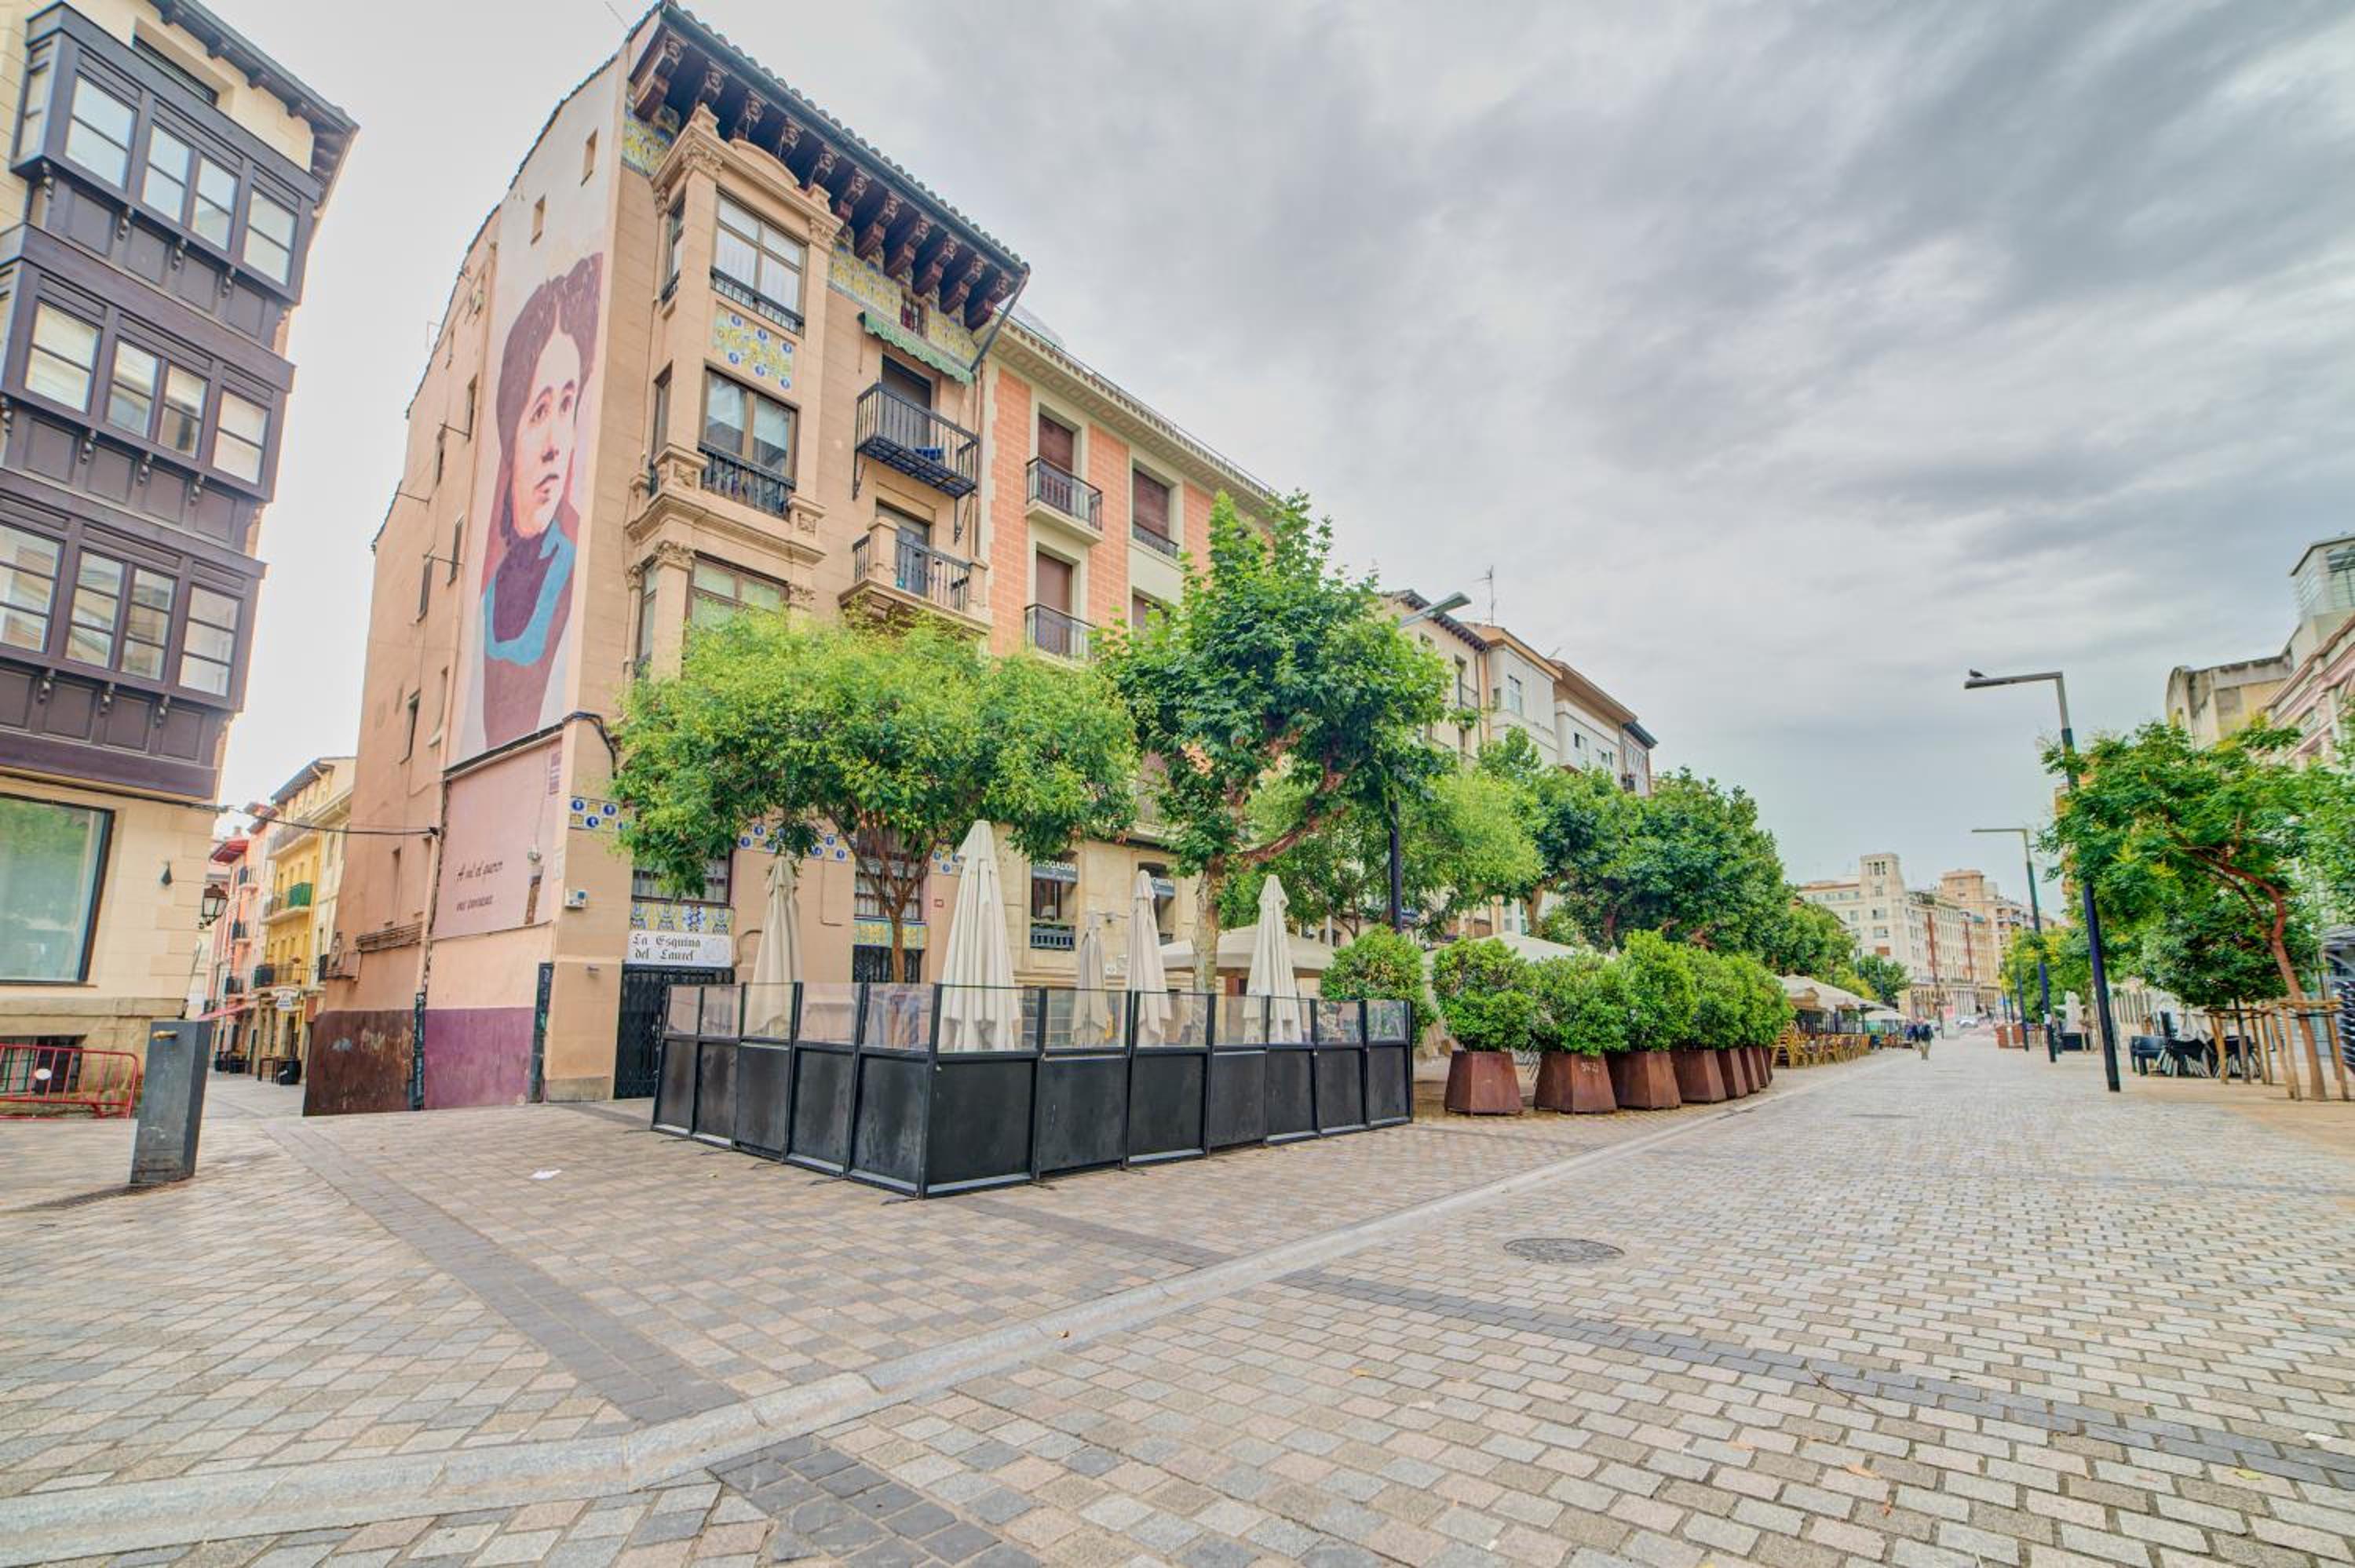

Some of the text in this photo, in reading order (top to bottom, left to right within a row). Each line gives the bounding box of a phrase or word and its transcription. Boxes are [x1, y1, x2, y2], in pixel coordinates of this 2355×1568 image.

[1034, 859, 1076, 872] OGADOS
[633, 933, 701, 948] La Esquina
[635, 947, 693, 961] del Laurel
